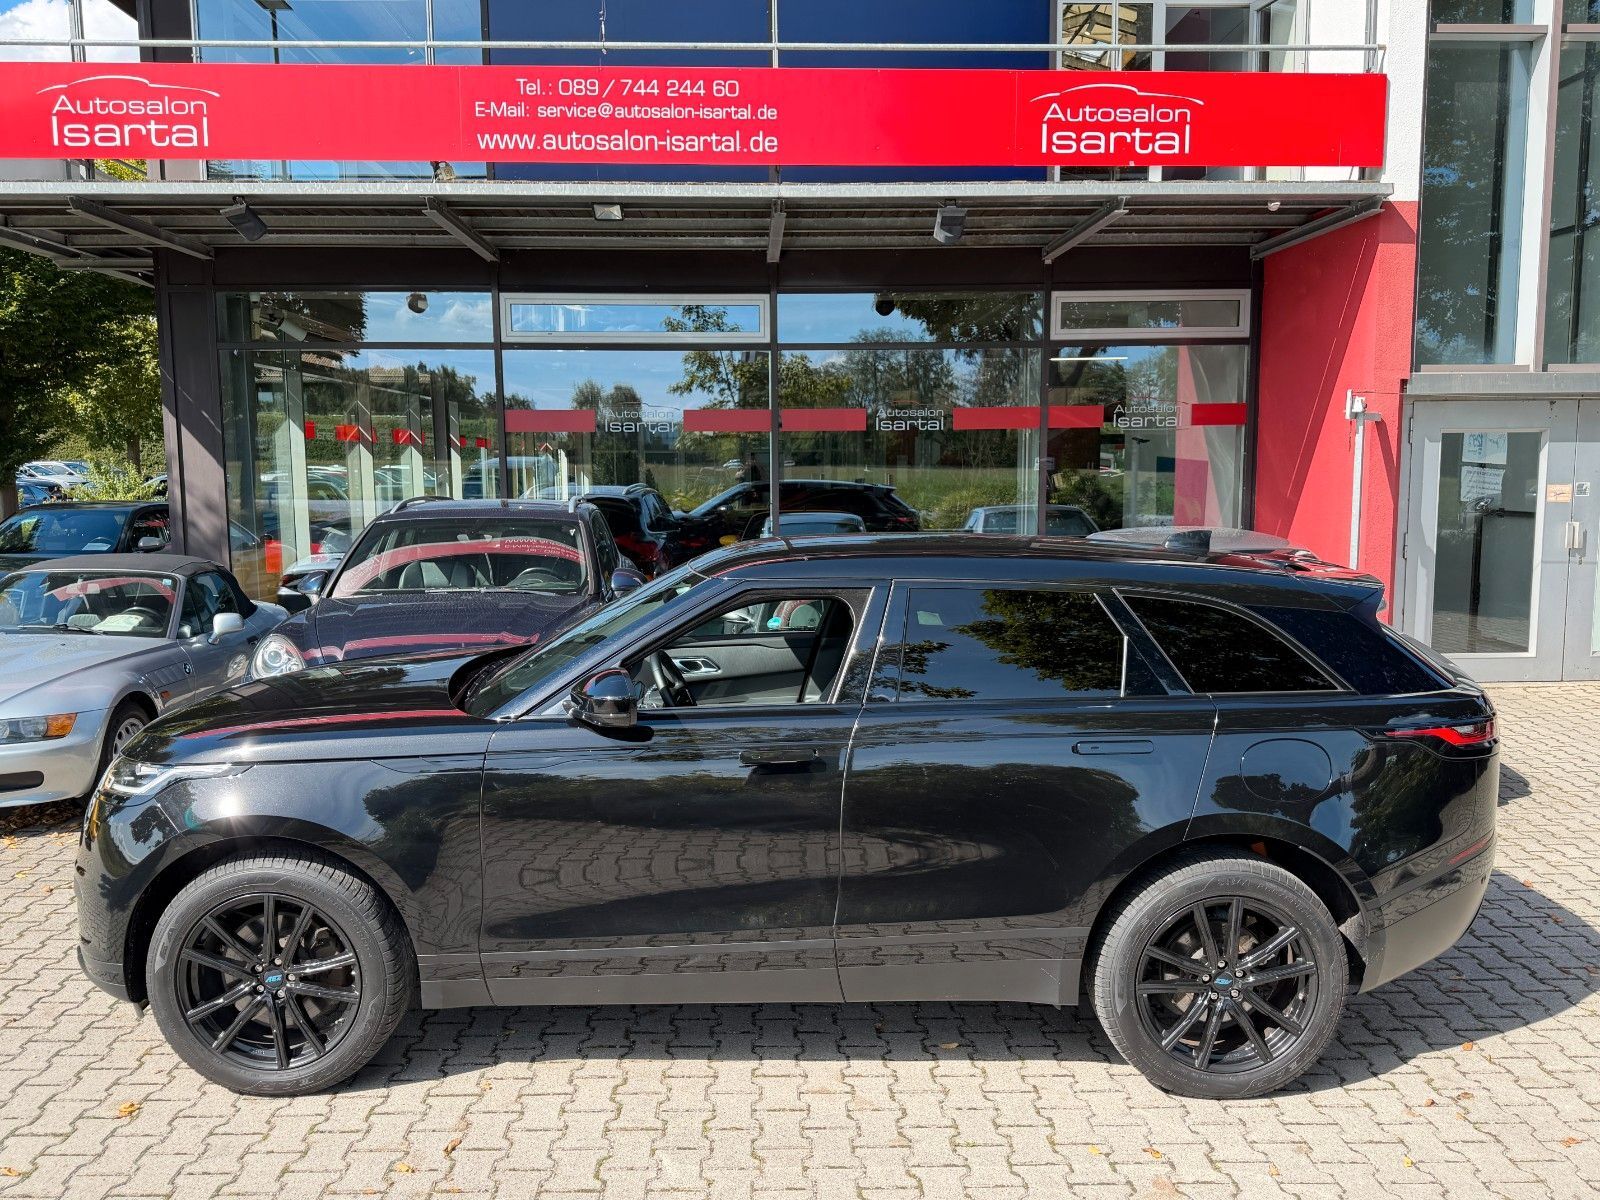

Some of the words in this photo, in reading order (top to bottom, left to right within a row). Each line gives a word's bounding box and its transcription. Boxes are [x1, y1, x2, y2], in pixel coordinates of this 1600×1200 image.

[515, 78, 552, 96] Tel.:
[558, 78, 599, 96] 089
[620, 79, 660, 96] 744
[666, 79, 706, 97] 244
[712, 79, 740, 97] 60
[52, 94, 208, 115] Autosalon
[475, 101, 530, 118] E-Mail:
[537, 102, 778, 120] service@autosalon-isartal.de
[1043, 102, 1191, 123] Autosalon
[51, 115, 209, 148] Isartal
[476, 128, 778, 153] www.autosalon-isartal.de
[1041, 123, 1191, 155] Isartal
[606, 409, 674, 419] Autosalon
[876, 407, 944, 417] Autosalon
[1113, 404, 1181, 414] Autosalon
[604, 419, 674, 433] Isartal
[875, 417, 944, 431] Isartal
[1113, 413, 1183, 428] Isartal
